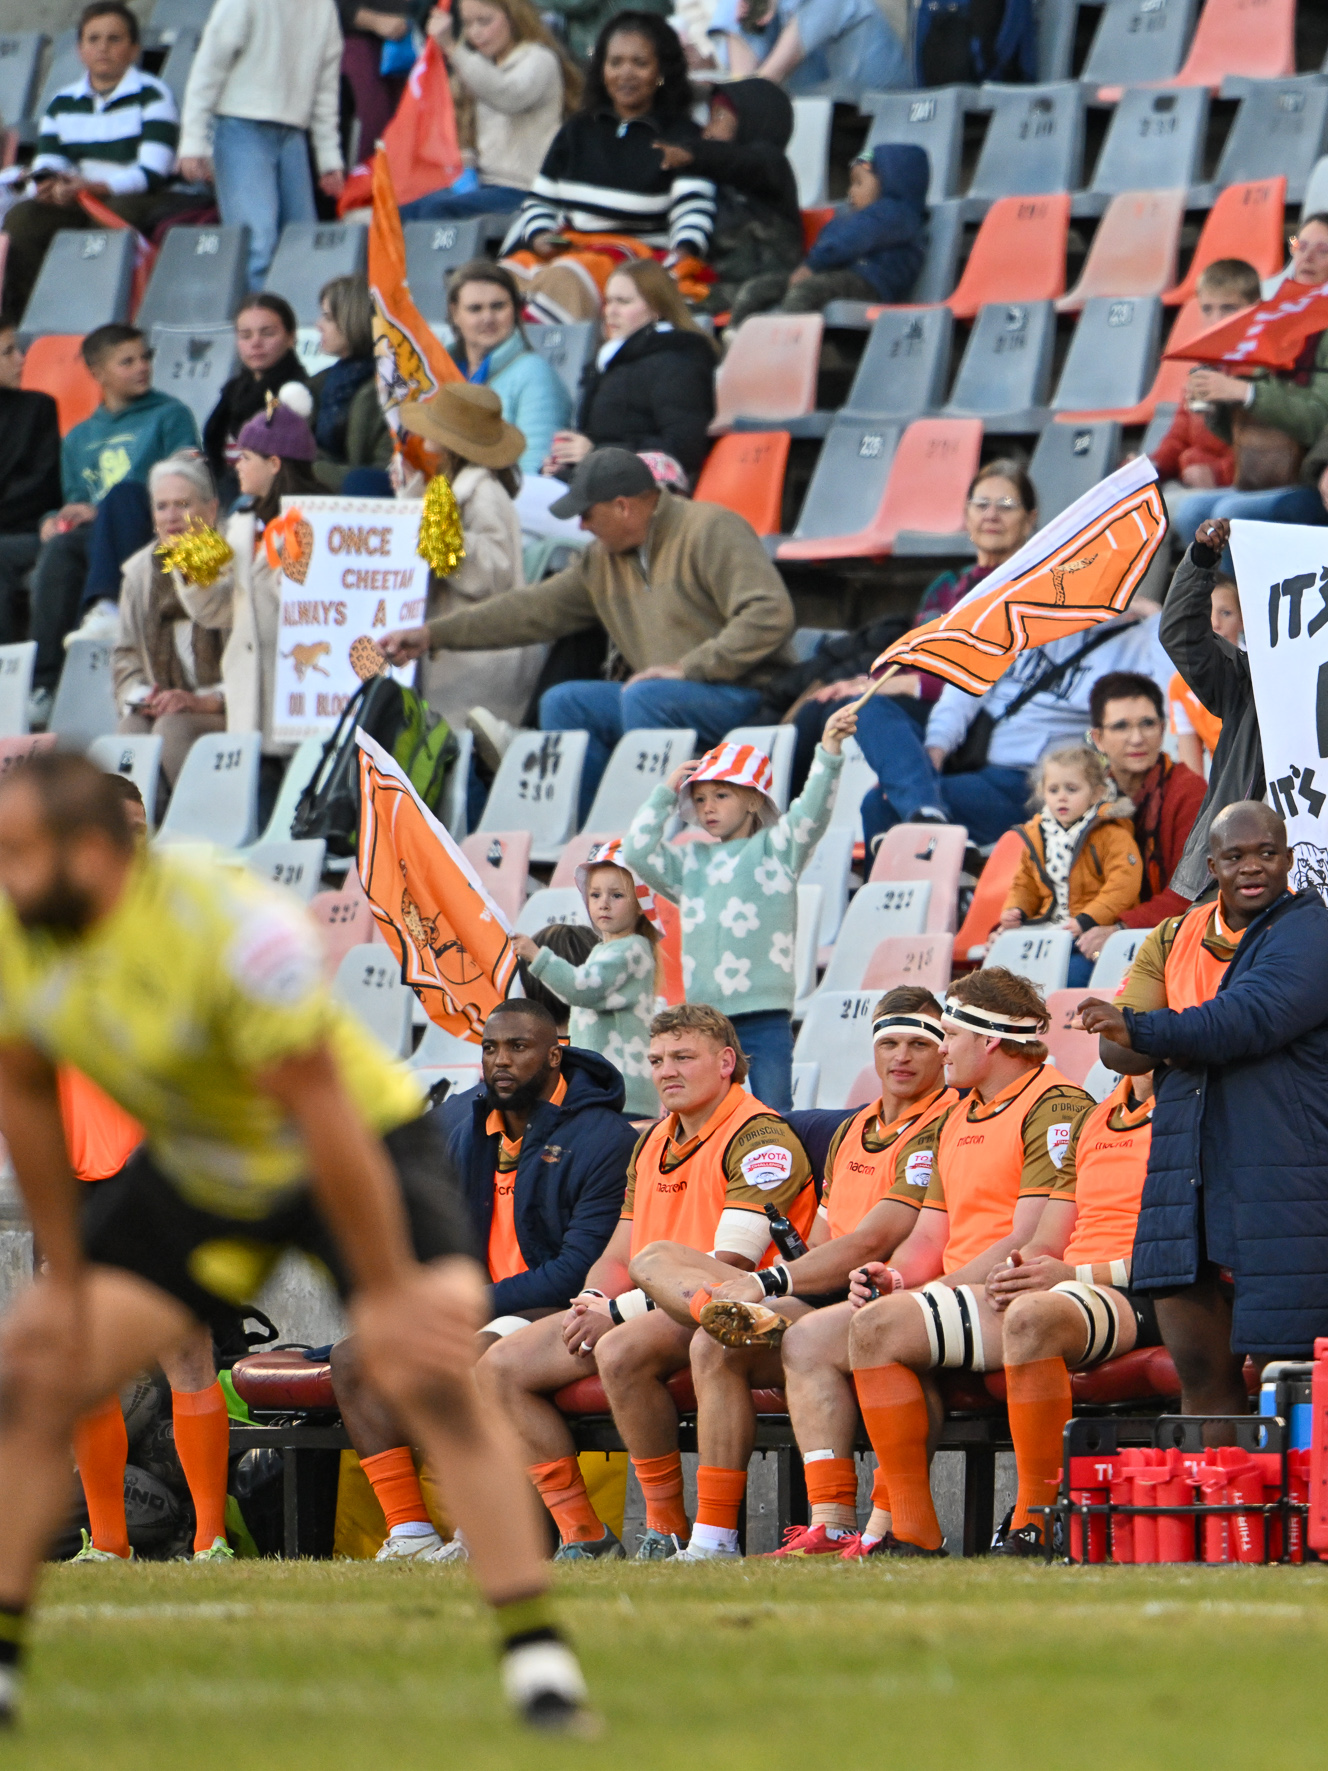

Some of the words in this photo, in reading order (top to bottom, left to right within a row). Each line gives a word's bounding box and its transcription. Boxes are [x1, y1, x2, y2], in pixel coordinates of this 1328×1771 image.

[327, 525, 393, 557] ONCE
[282, 601, 347, 627] ALWAYS
[372, 598, 387, 629] A
[1268, 764, 1326, 821] IT'S
[1021, 938, 1052, 960] 217
[844, 998, 870, 1019] 216
[748, 1152, 787, 1162] OYOTA
[1234, 1492, 1251, 1552] THIRTI
